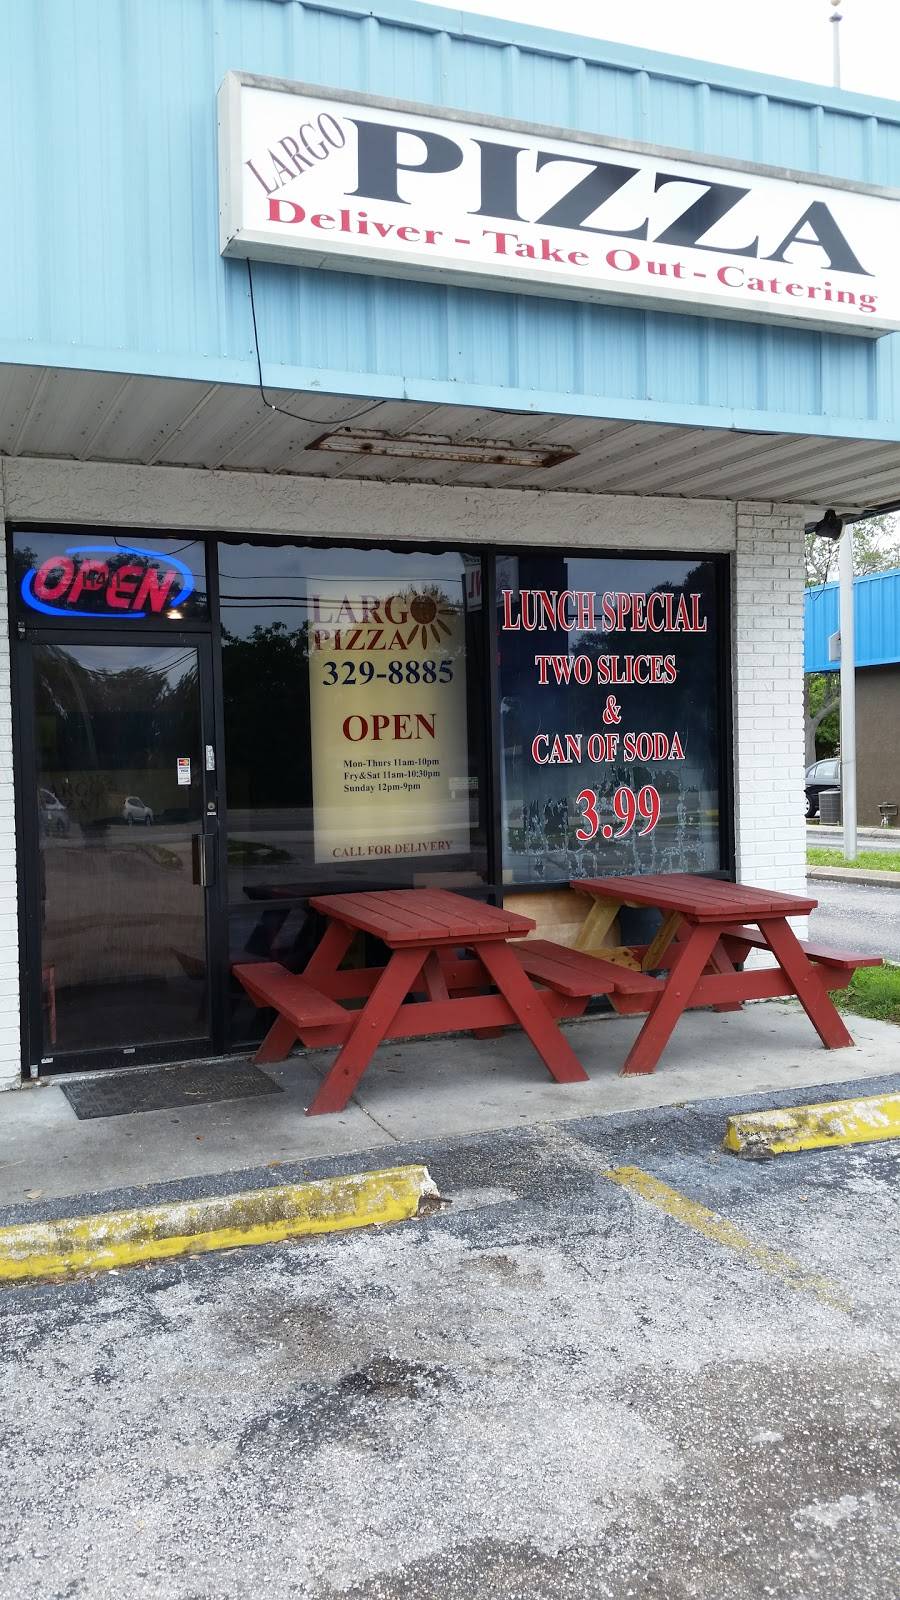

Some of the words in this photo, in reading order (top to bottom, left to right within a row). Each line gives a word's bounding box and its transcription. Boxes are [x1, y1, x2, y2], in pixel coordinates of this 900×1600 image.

[246, 112, 346, 196] LARGO
[343, 117, 876, 277] PIZZA
[266, 197, 443, 245] Deliver
[482, 230, 590, 266] Take
[605, 249, 687, 280] Out
[717, 265, 878, 313] Catering
[34, 556, 176, 613] OPEN
[501, 589, 597, 632] LUNCH
[601, 591, 708, 633] SPECIAL
[313, 629, 408, 651] PIZZA
[322, 660, 454, 686] 329-8885
[535, 655, 593, 685] TWO
[597, 655, 677, 685] SLICES
[602, 694, 622, 724] &
[342, 713, 437, 742] OPEN
[531, 733, 583, 764] CAN
[587, 733, 620, 763] OF
[623, 731, 686, 762] SODA
[343, 759, 391, 768] Mon-Thurs
[394, 758, 440, 768] 11am-10pm
[343, 771, 380, 782] Fry&Sat
[383, 769, 441, 779] 11am-10:30pm
[343, 784, 375, 793] Sunday
[378, 782, 421, 792] 12pm-9pm
[575, 785, 661, 841] 3.99
[332, 846, 366, 858] CALL
[367, 844, 392, 856] FOR
[394, 840, 453, 853] DELIVERY
